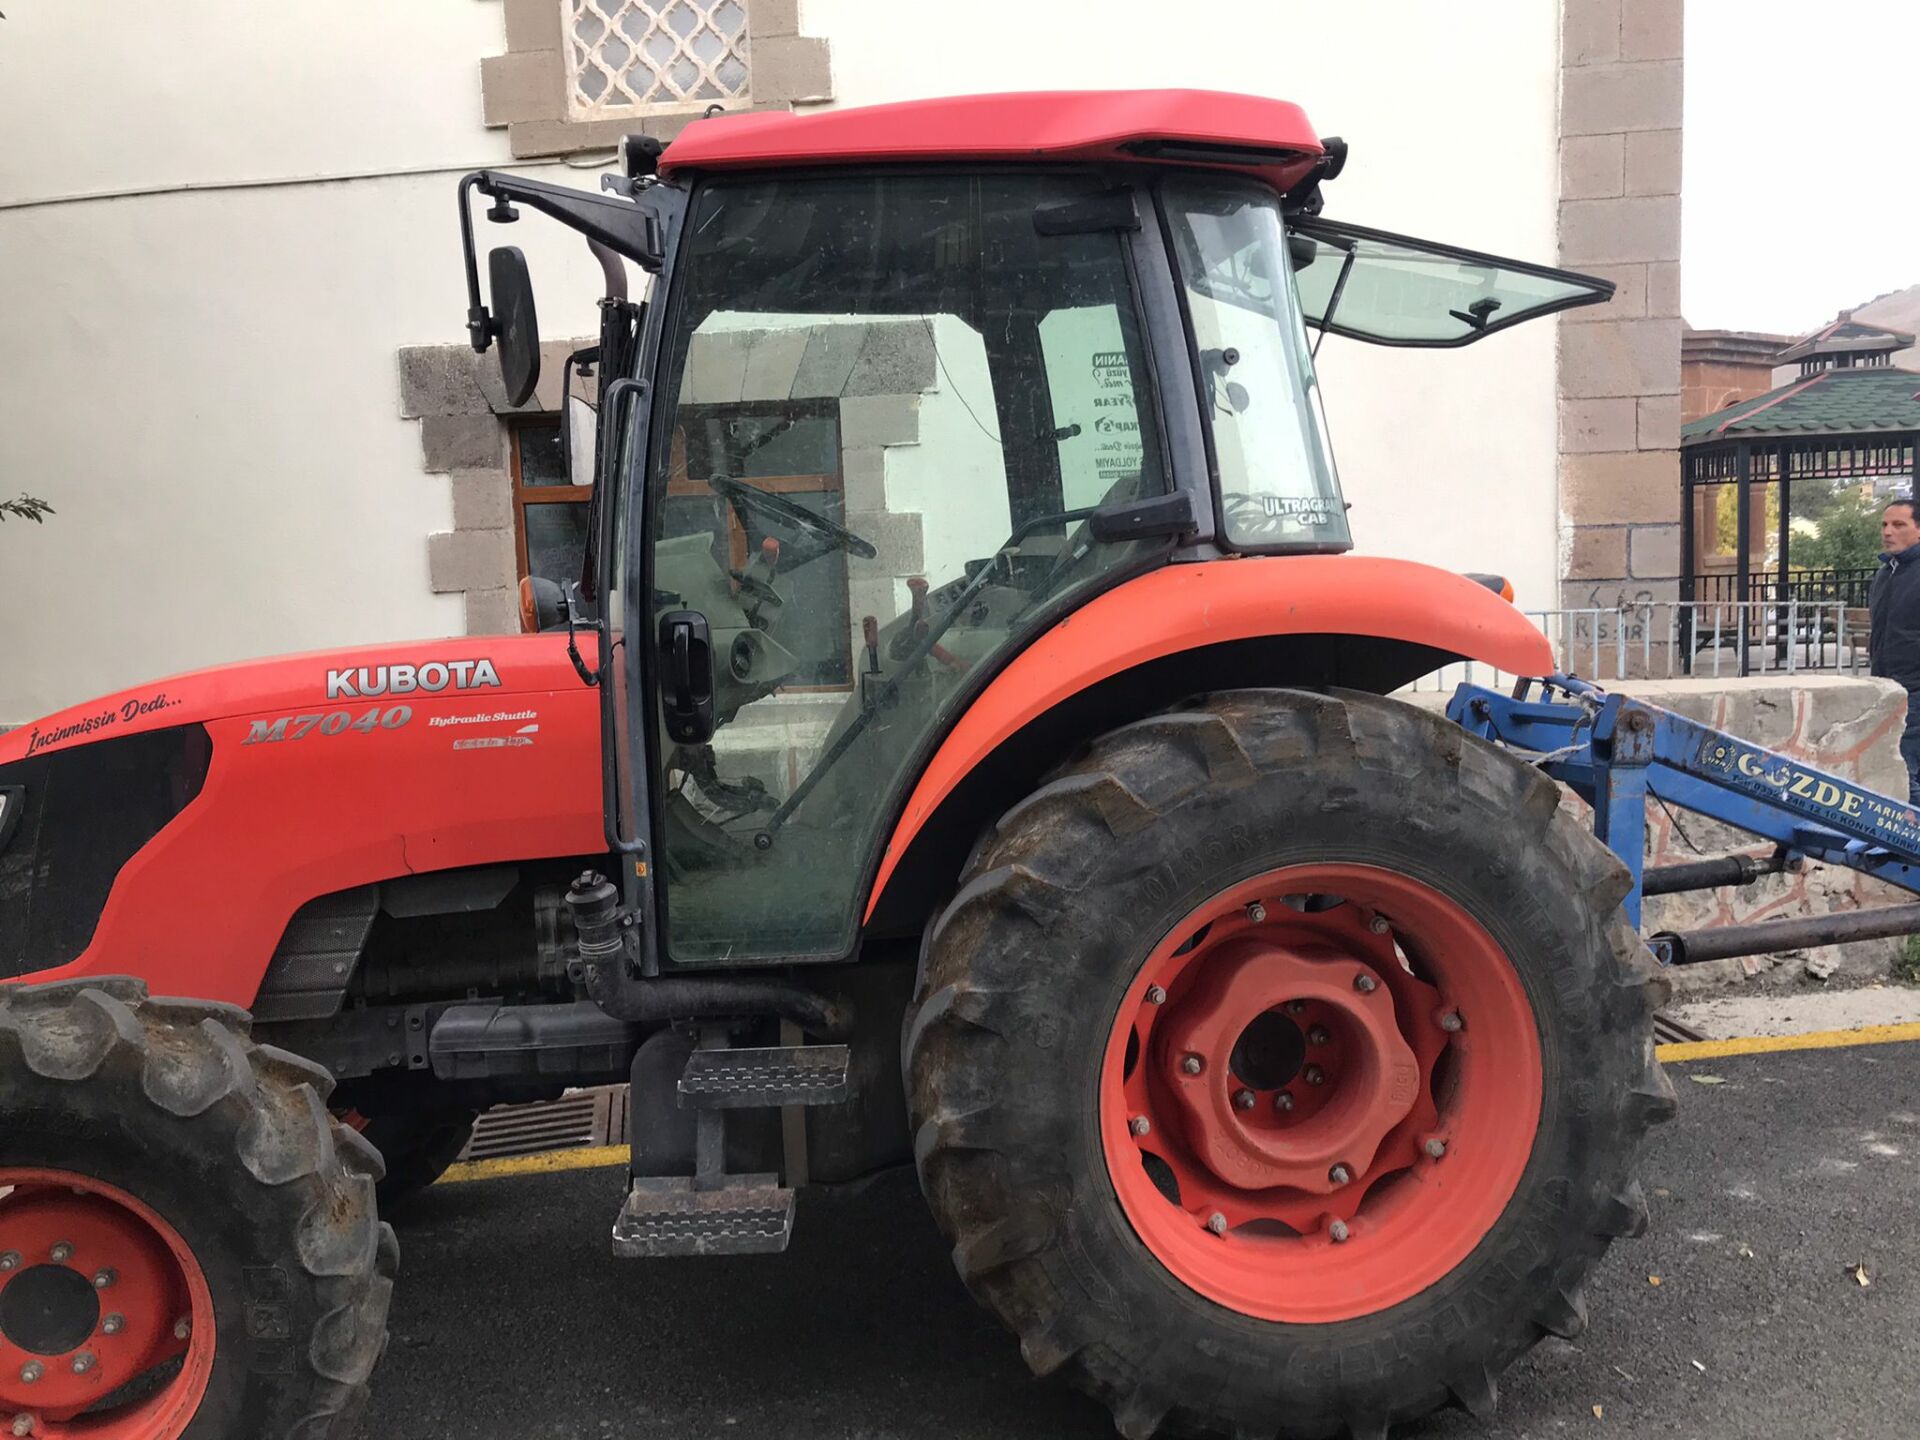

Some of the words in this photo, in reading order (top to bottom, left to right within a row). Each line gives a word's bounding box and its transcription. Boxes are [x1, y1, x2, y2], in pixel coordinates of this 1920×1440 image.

[1297, 512, 1328, 525] CAB
[326, 659, 502, 699] KUBOTA
[240, 704, 413, 746] M7040
[428, 714, 492, 727] Hydraulic
[492, 710, 537, 722] Shuttle
